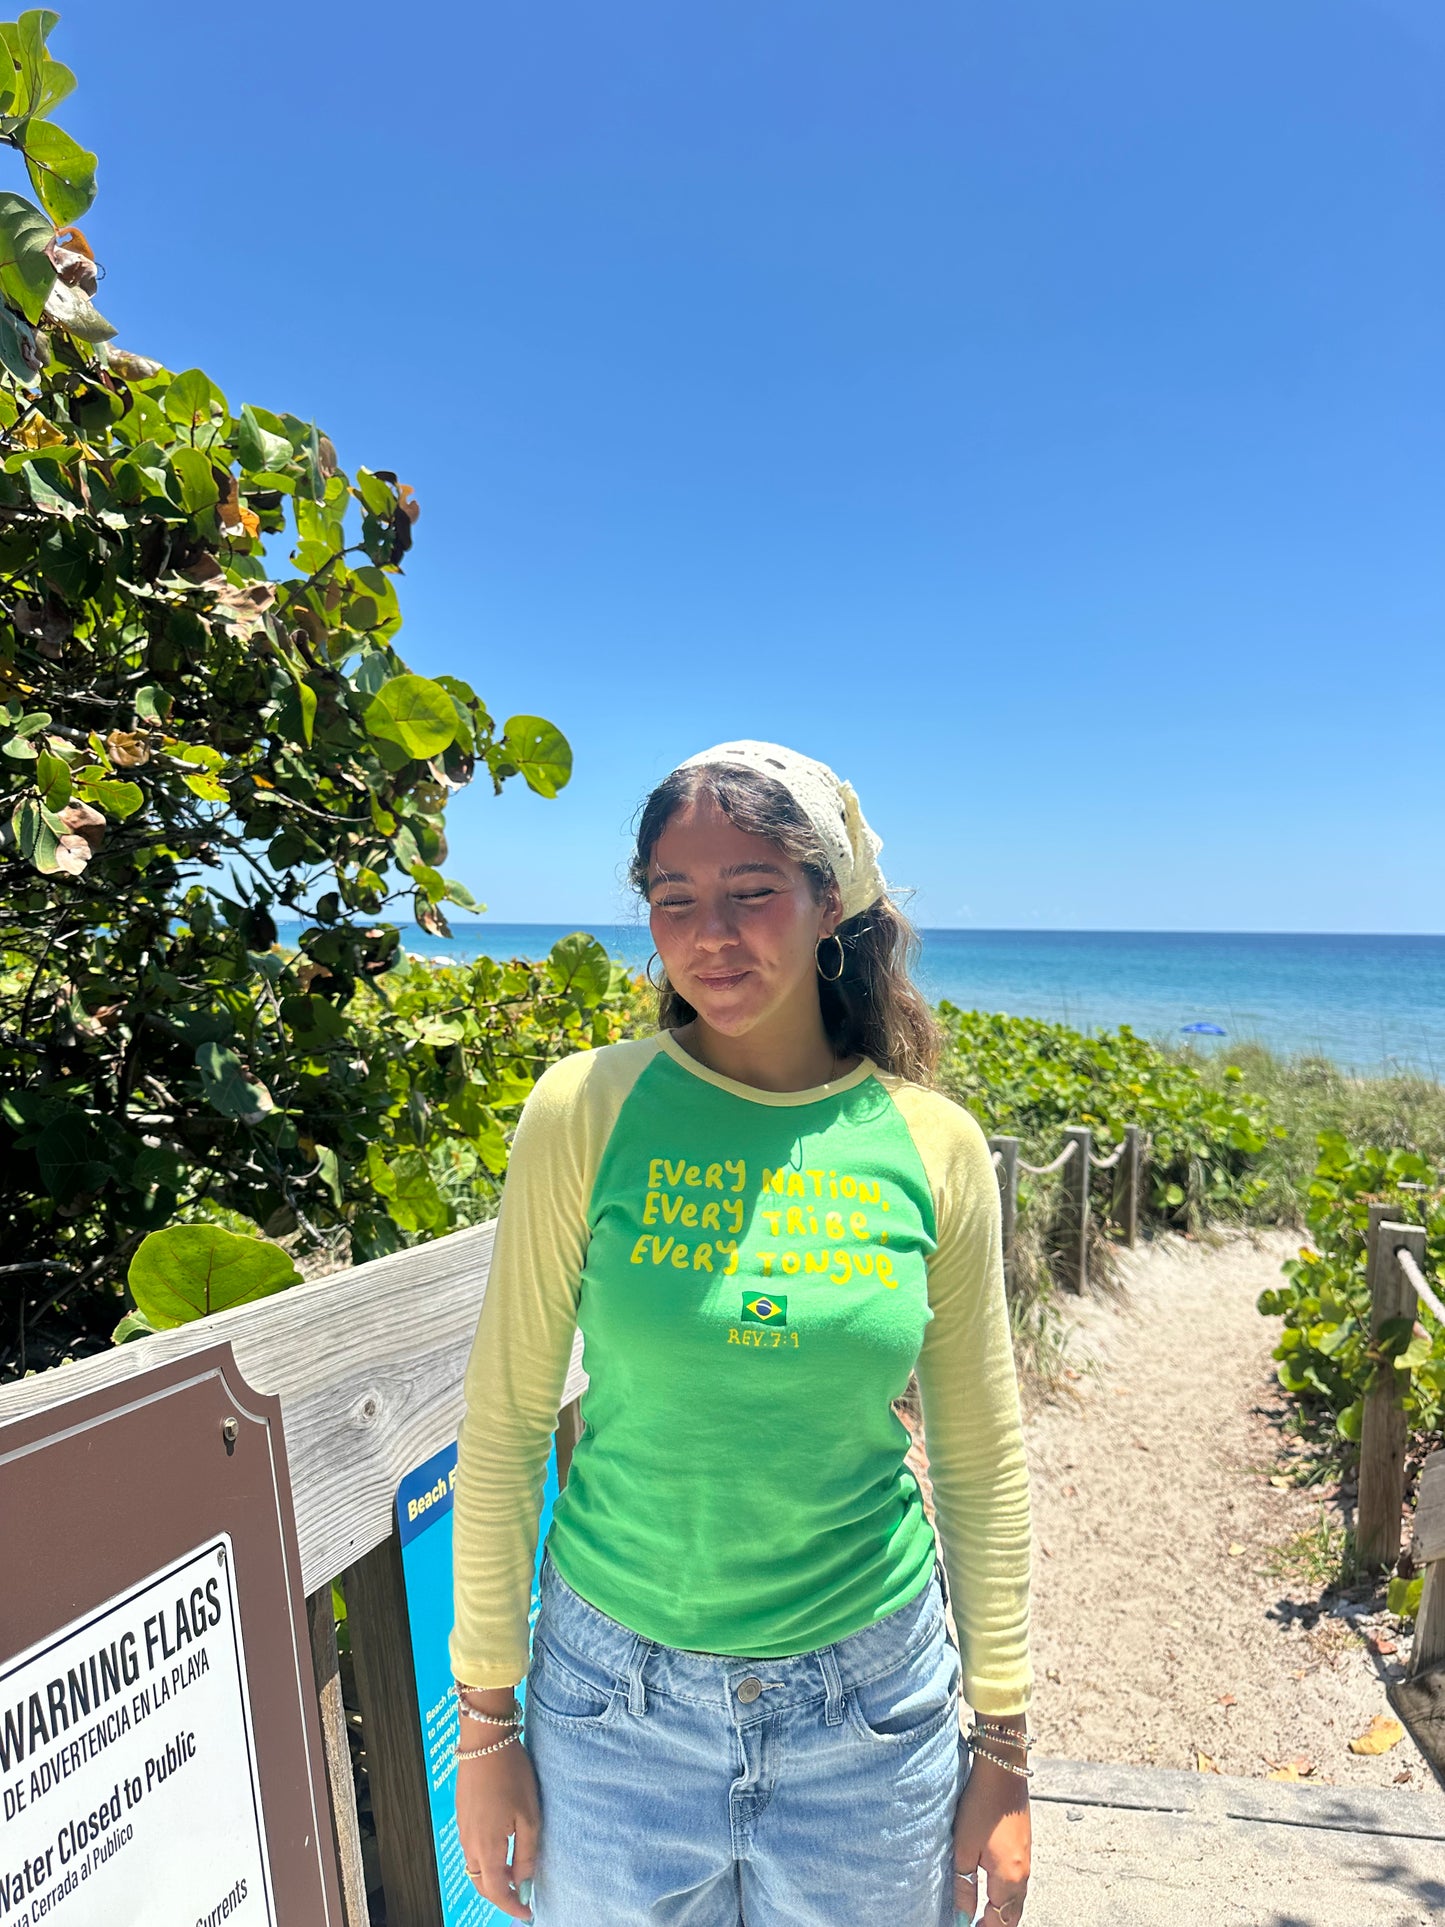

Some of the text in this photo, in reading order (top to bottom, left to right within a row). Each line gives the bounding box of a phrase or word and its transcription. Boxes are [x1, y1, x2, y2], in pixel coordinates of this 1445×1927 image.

[408, 1477, 447, 1522] Beach
[0, 1577, 221, 1773] WARNING FLAGS
[426, 1695, 447, 1724] Beach
[3, 1647, 210, 1822] DE ADVERTENCIA EN LA PLAYA
[57, 1784, 122, 1865] Closed
[124, 1776, 143, 1810] to
[144, 1731, 196, 1793] Public
[31, 1823, 134, 1923] Cerrada al Publico
